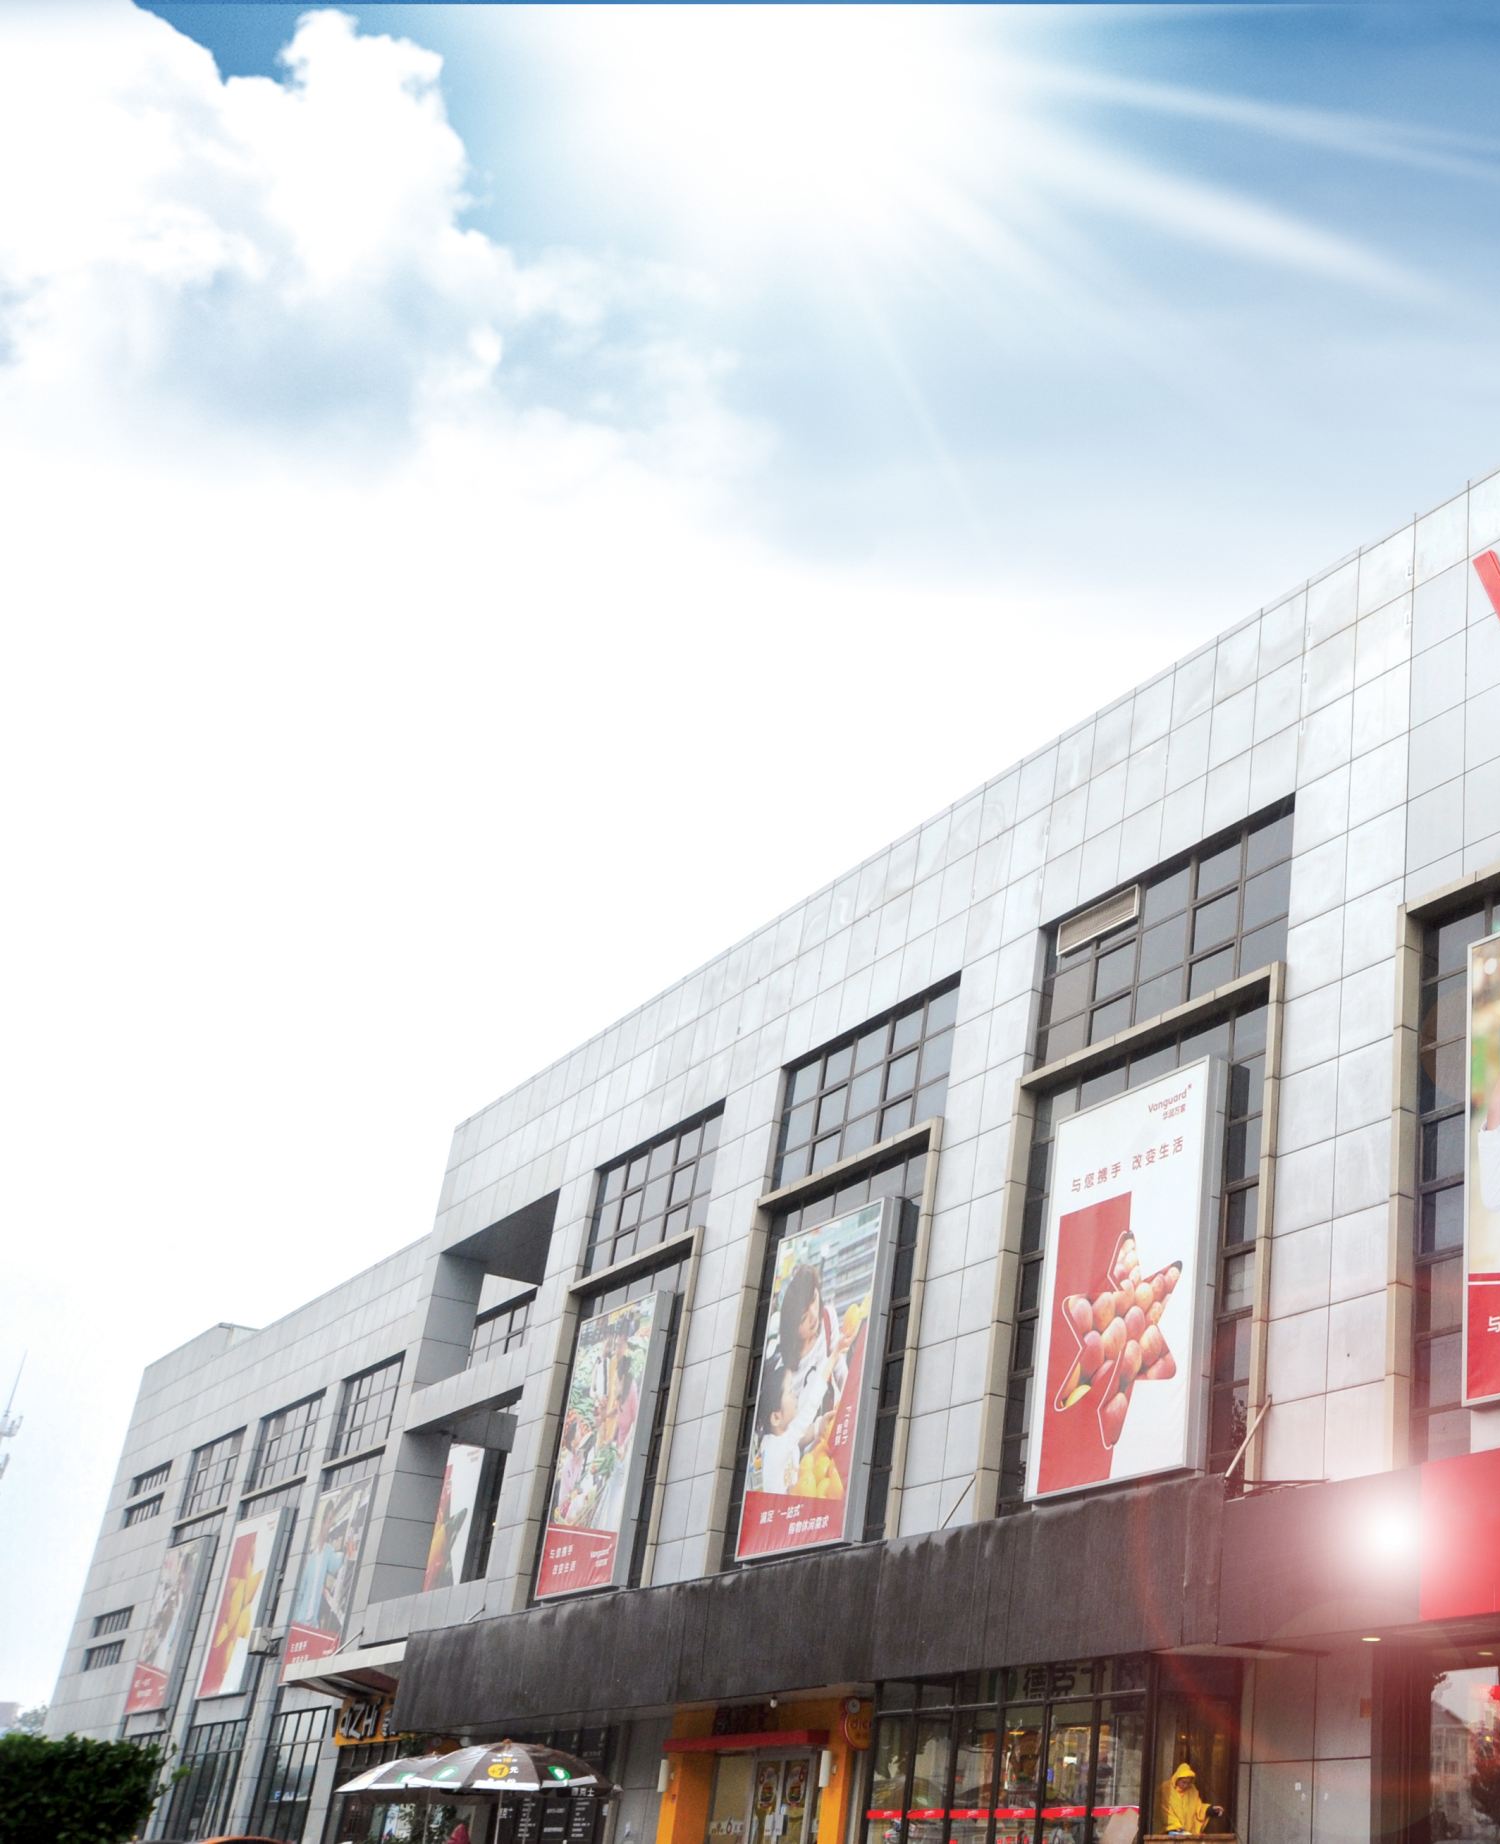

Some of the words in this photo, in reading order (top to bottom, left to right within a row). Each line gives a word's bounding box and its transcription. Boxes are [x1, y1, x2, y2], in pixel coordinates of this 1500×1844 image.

[1071, 1161, 1122, 1193] 与您携手
[1131, 1136, 1184, 1171] 改变生活
